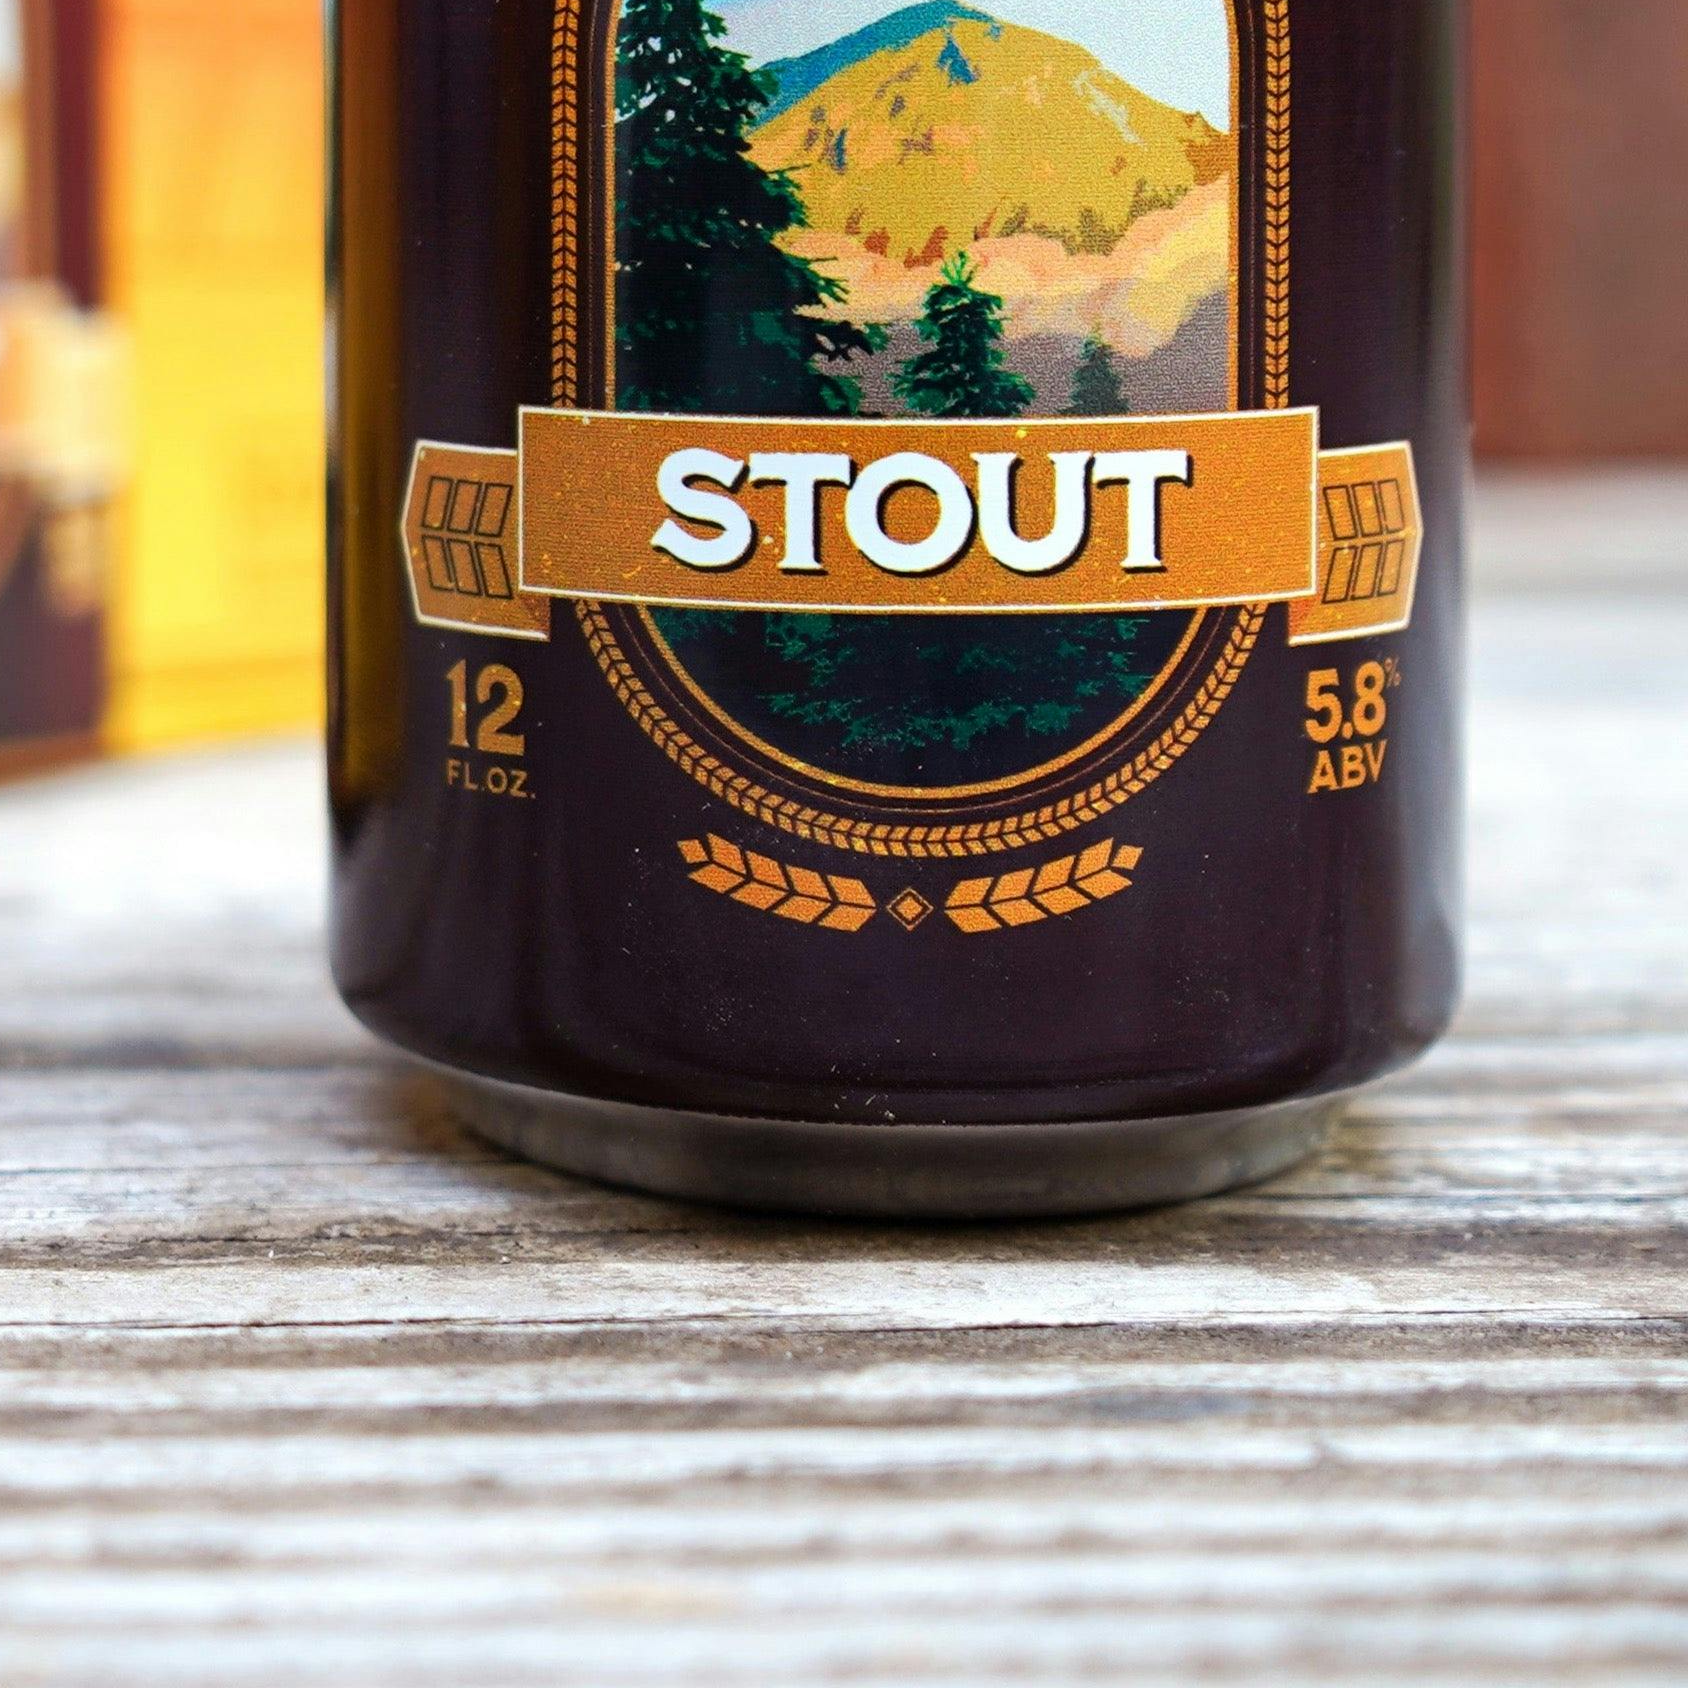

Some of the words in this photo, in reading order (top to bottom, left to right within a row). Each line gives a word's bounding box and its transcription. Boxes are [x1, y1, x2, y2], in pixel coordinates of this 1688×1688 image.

[650, 446, 1194, 578] STOUT
[445, 658, 526, 757] 12
[1307, 738, 1388, 794] ABV
